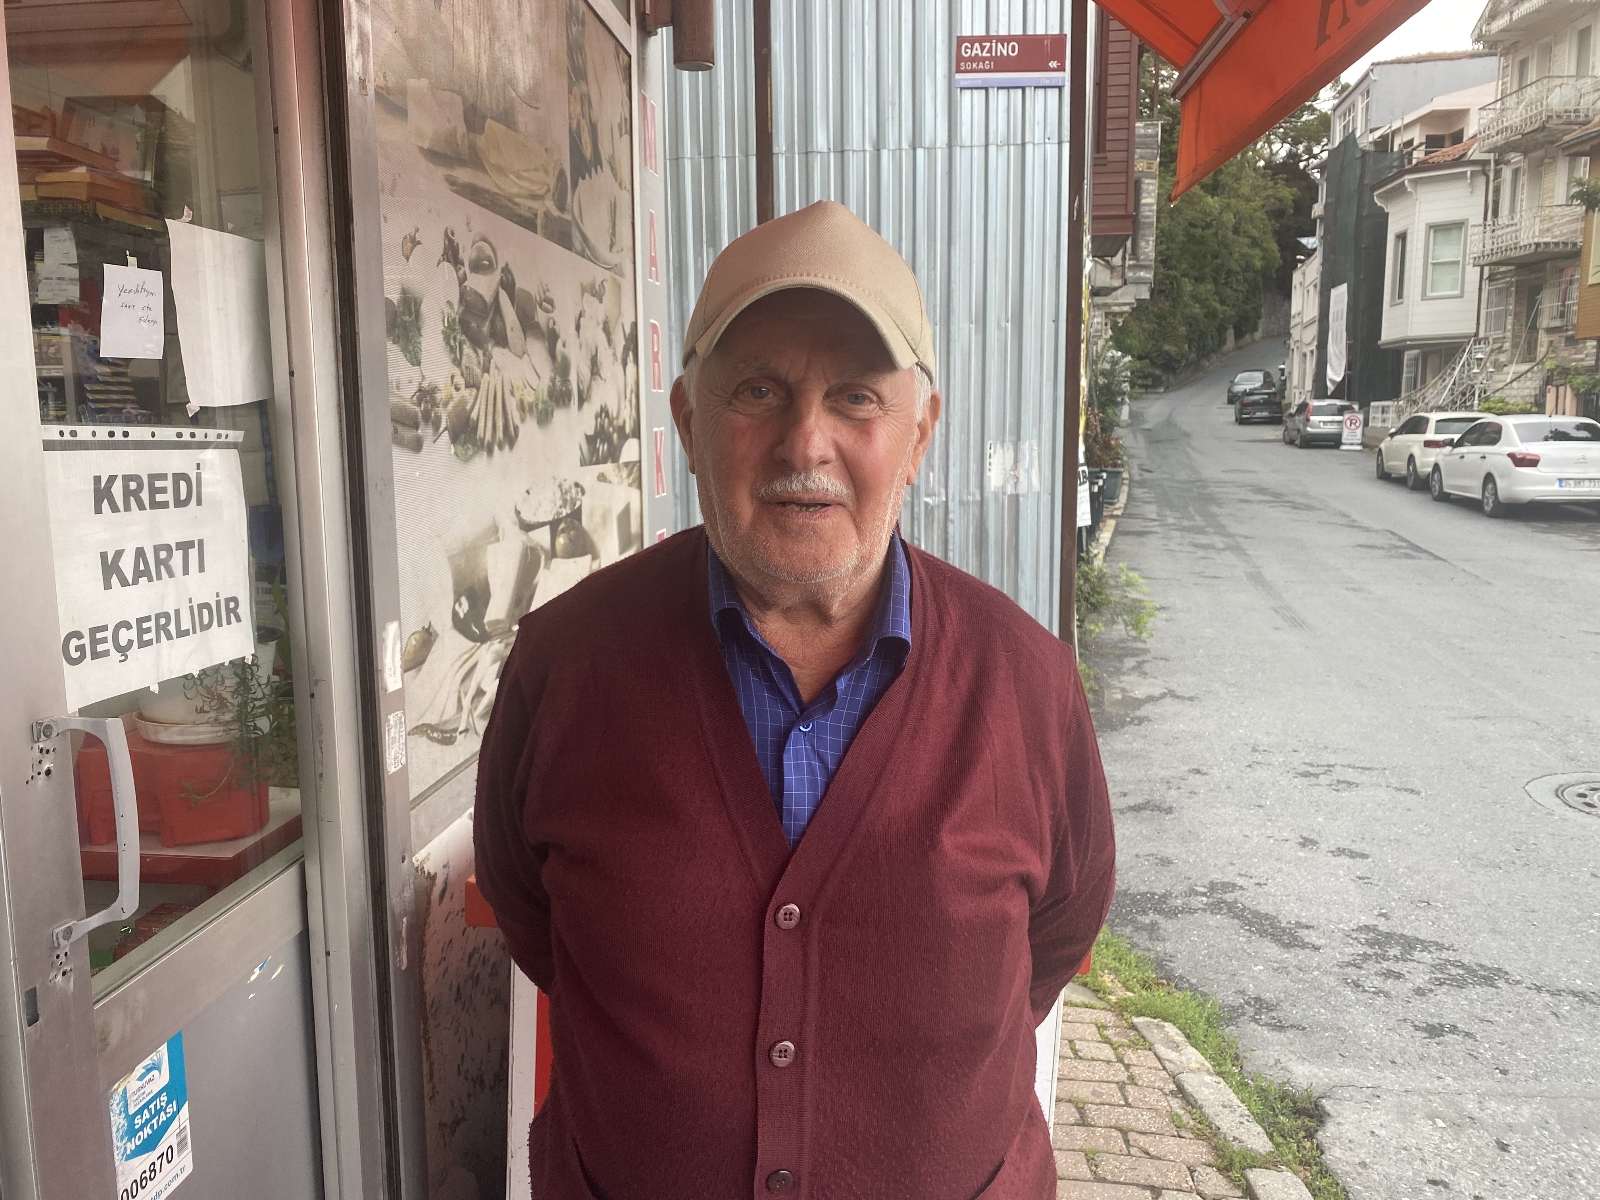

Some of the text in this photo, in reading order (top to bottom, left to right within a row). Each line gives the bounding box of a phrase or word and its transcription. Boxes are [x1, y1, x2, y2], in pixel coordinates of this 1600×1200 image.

[960, 60, 994, 70] SOKAĞI
[961, 39, 1019, 57] GAZİNO
[641, 88, 667, 543] MARK
[92, 462, 203, 515] KREDİ
[99, 538, 206, 591] KARTI
[61, 591, 243, 667] GEÇERLİDİR
[126, 1099, 177, 1155] NOKTASI
[134, 1091, 168, 1129] SATIŞ
